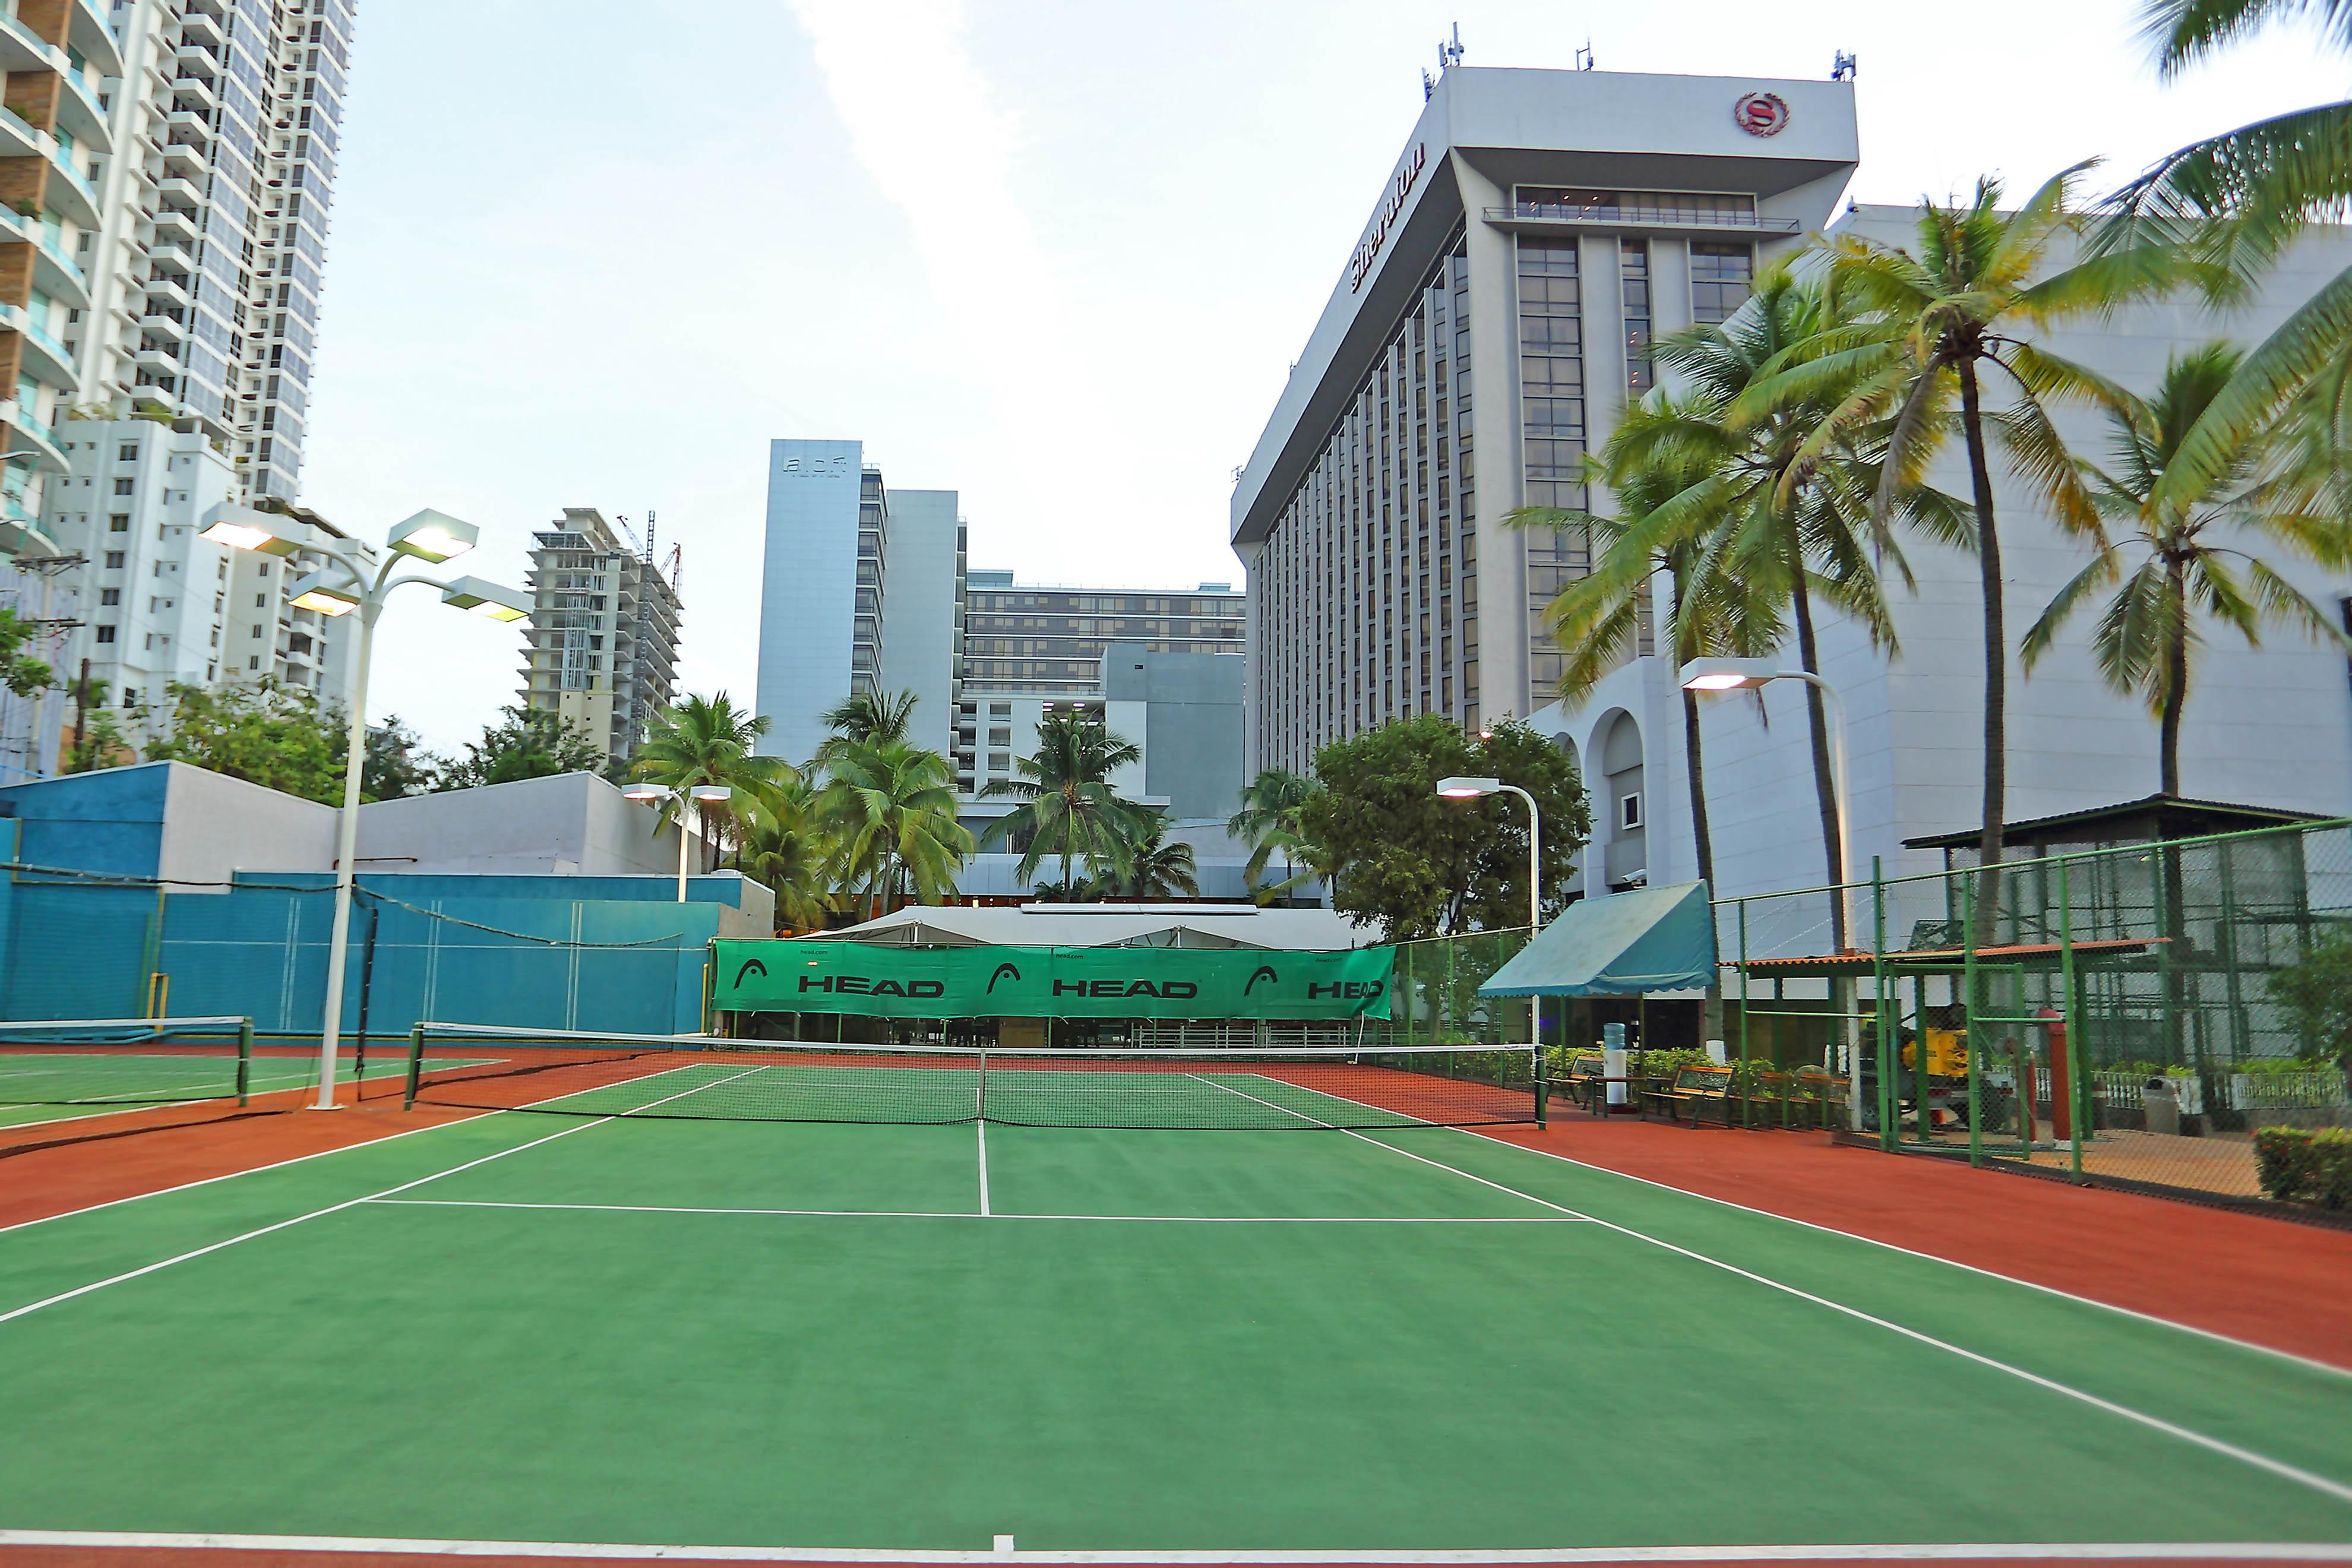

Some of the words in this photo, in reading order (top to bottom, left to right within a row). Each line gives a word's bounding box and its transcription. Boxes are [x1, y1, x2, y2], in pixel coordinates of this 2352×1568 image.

[1746, 100, 1776, 127] S
[798, 976, 944, 998] HEAD
[1052, 979, 1197, 999] HEAD
[1308, 980, 1384, 999] HEAD
